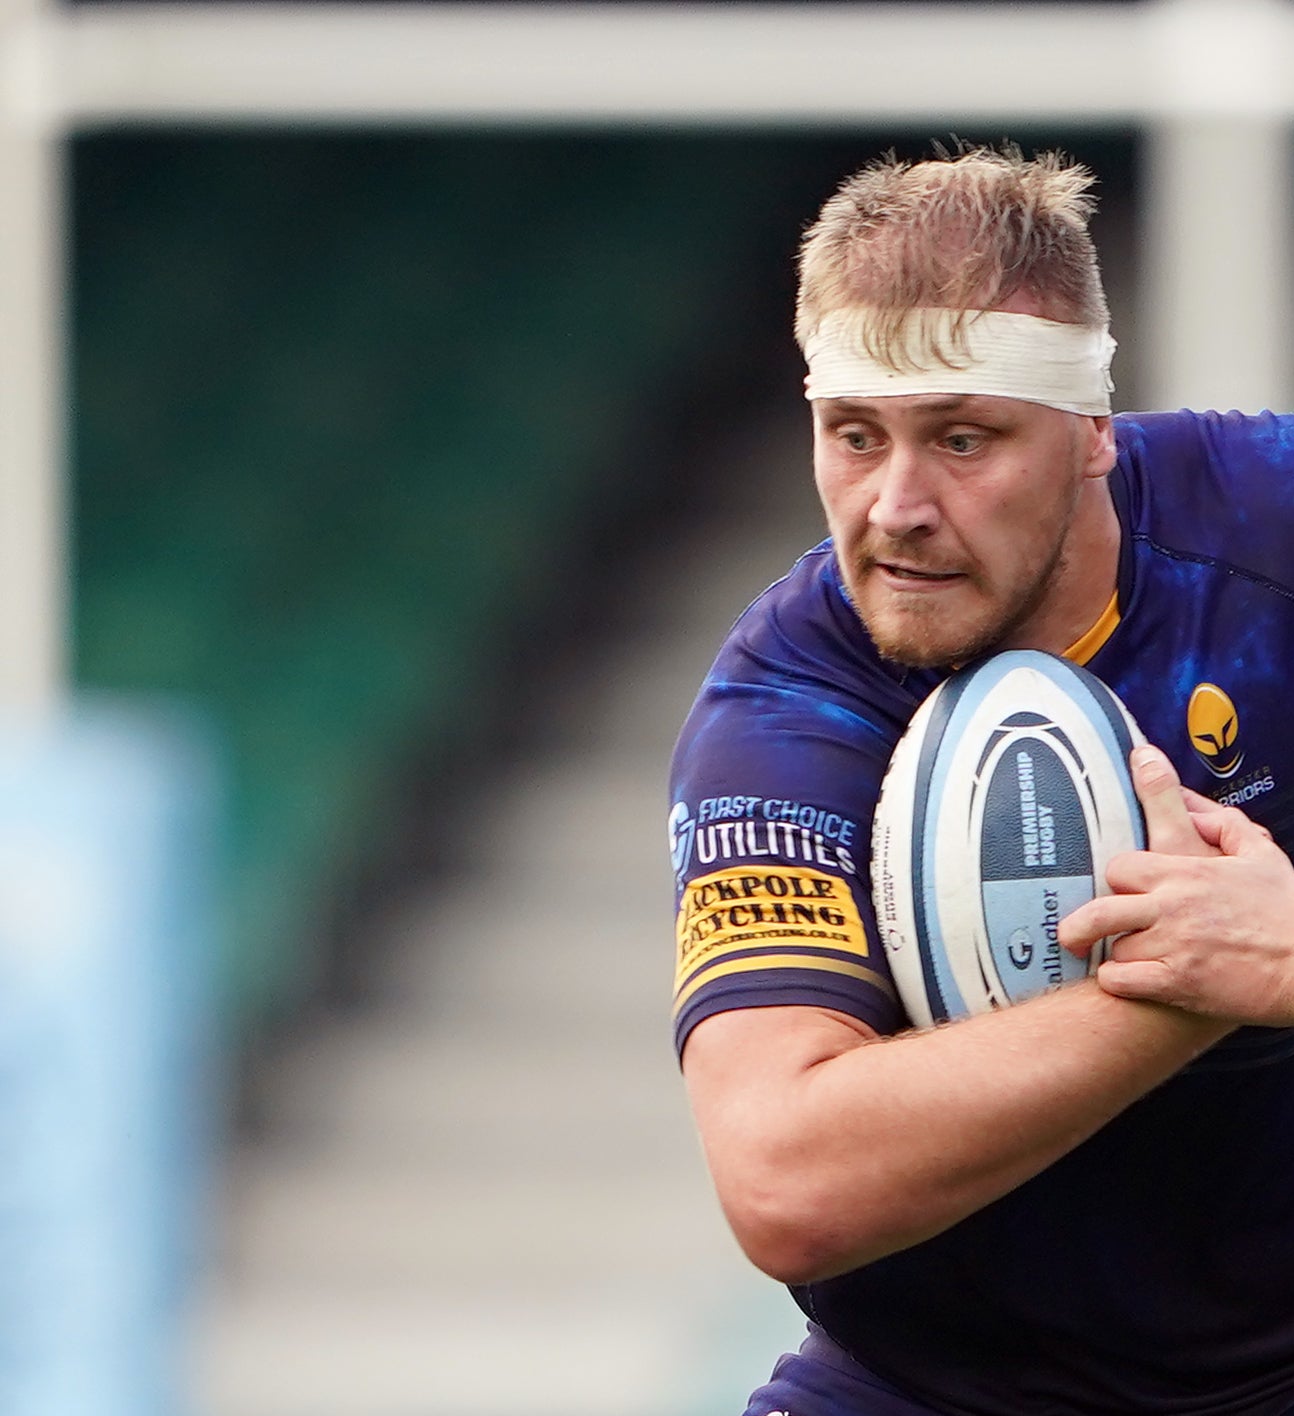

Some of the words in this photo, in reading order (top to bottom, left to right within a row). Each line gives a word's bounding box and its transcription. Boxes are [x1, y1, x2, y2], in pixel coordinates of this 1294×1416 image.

[697, 796, 764, 823] FIRST
[763, 799, 857, 846] CHOICE
[1017, 751, 1040, 867] PREMIERSHIP
[1037, 804, 1057, 866] RUGBY
[696, 821, 857, 874] UTILITIES
[1040, 888, 1063, 988] allagher
